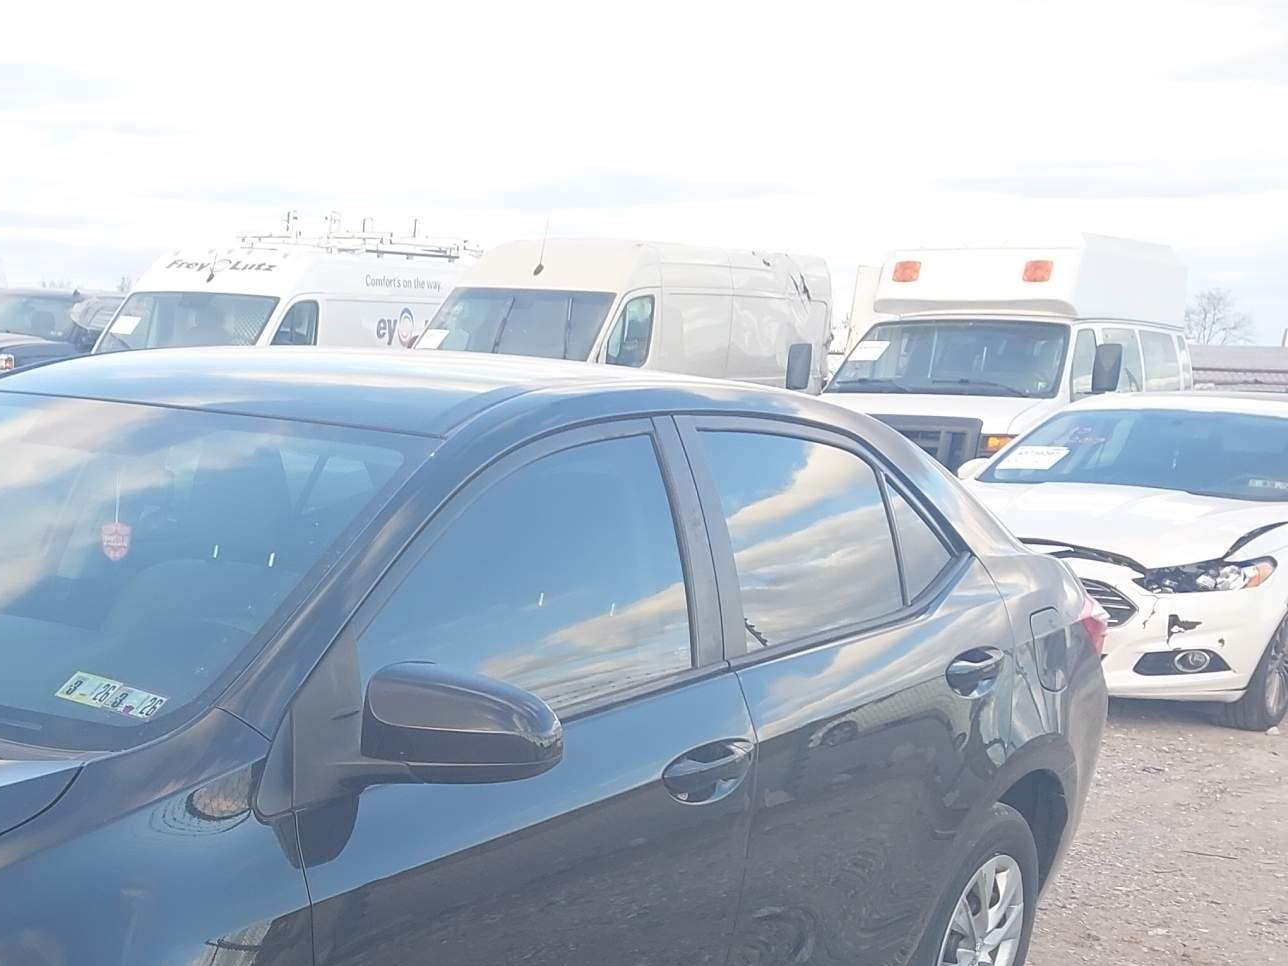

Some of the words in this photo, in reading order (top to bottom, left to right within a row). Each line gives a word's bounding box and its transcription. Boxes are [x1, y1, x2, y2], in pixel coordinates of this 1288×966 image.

[229, 260, 278, 272] Lutz
[402, 279, 413, 289] on
[414, 278, 426, 289] the
[426, 281, 441, 292] way
